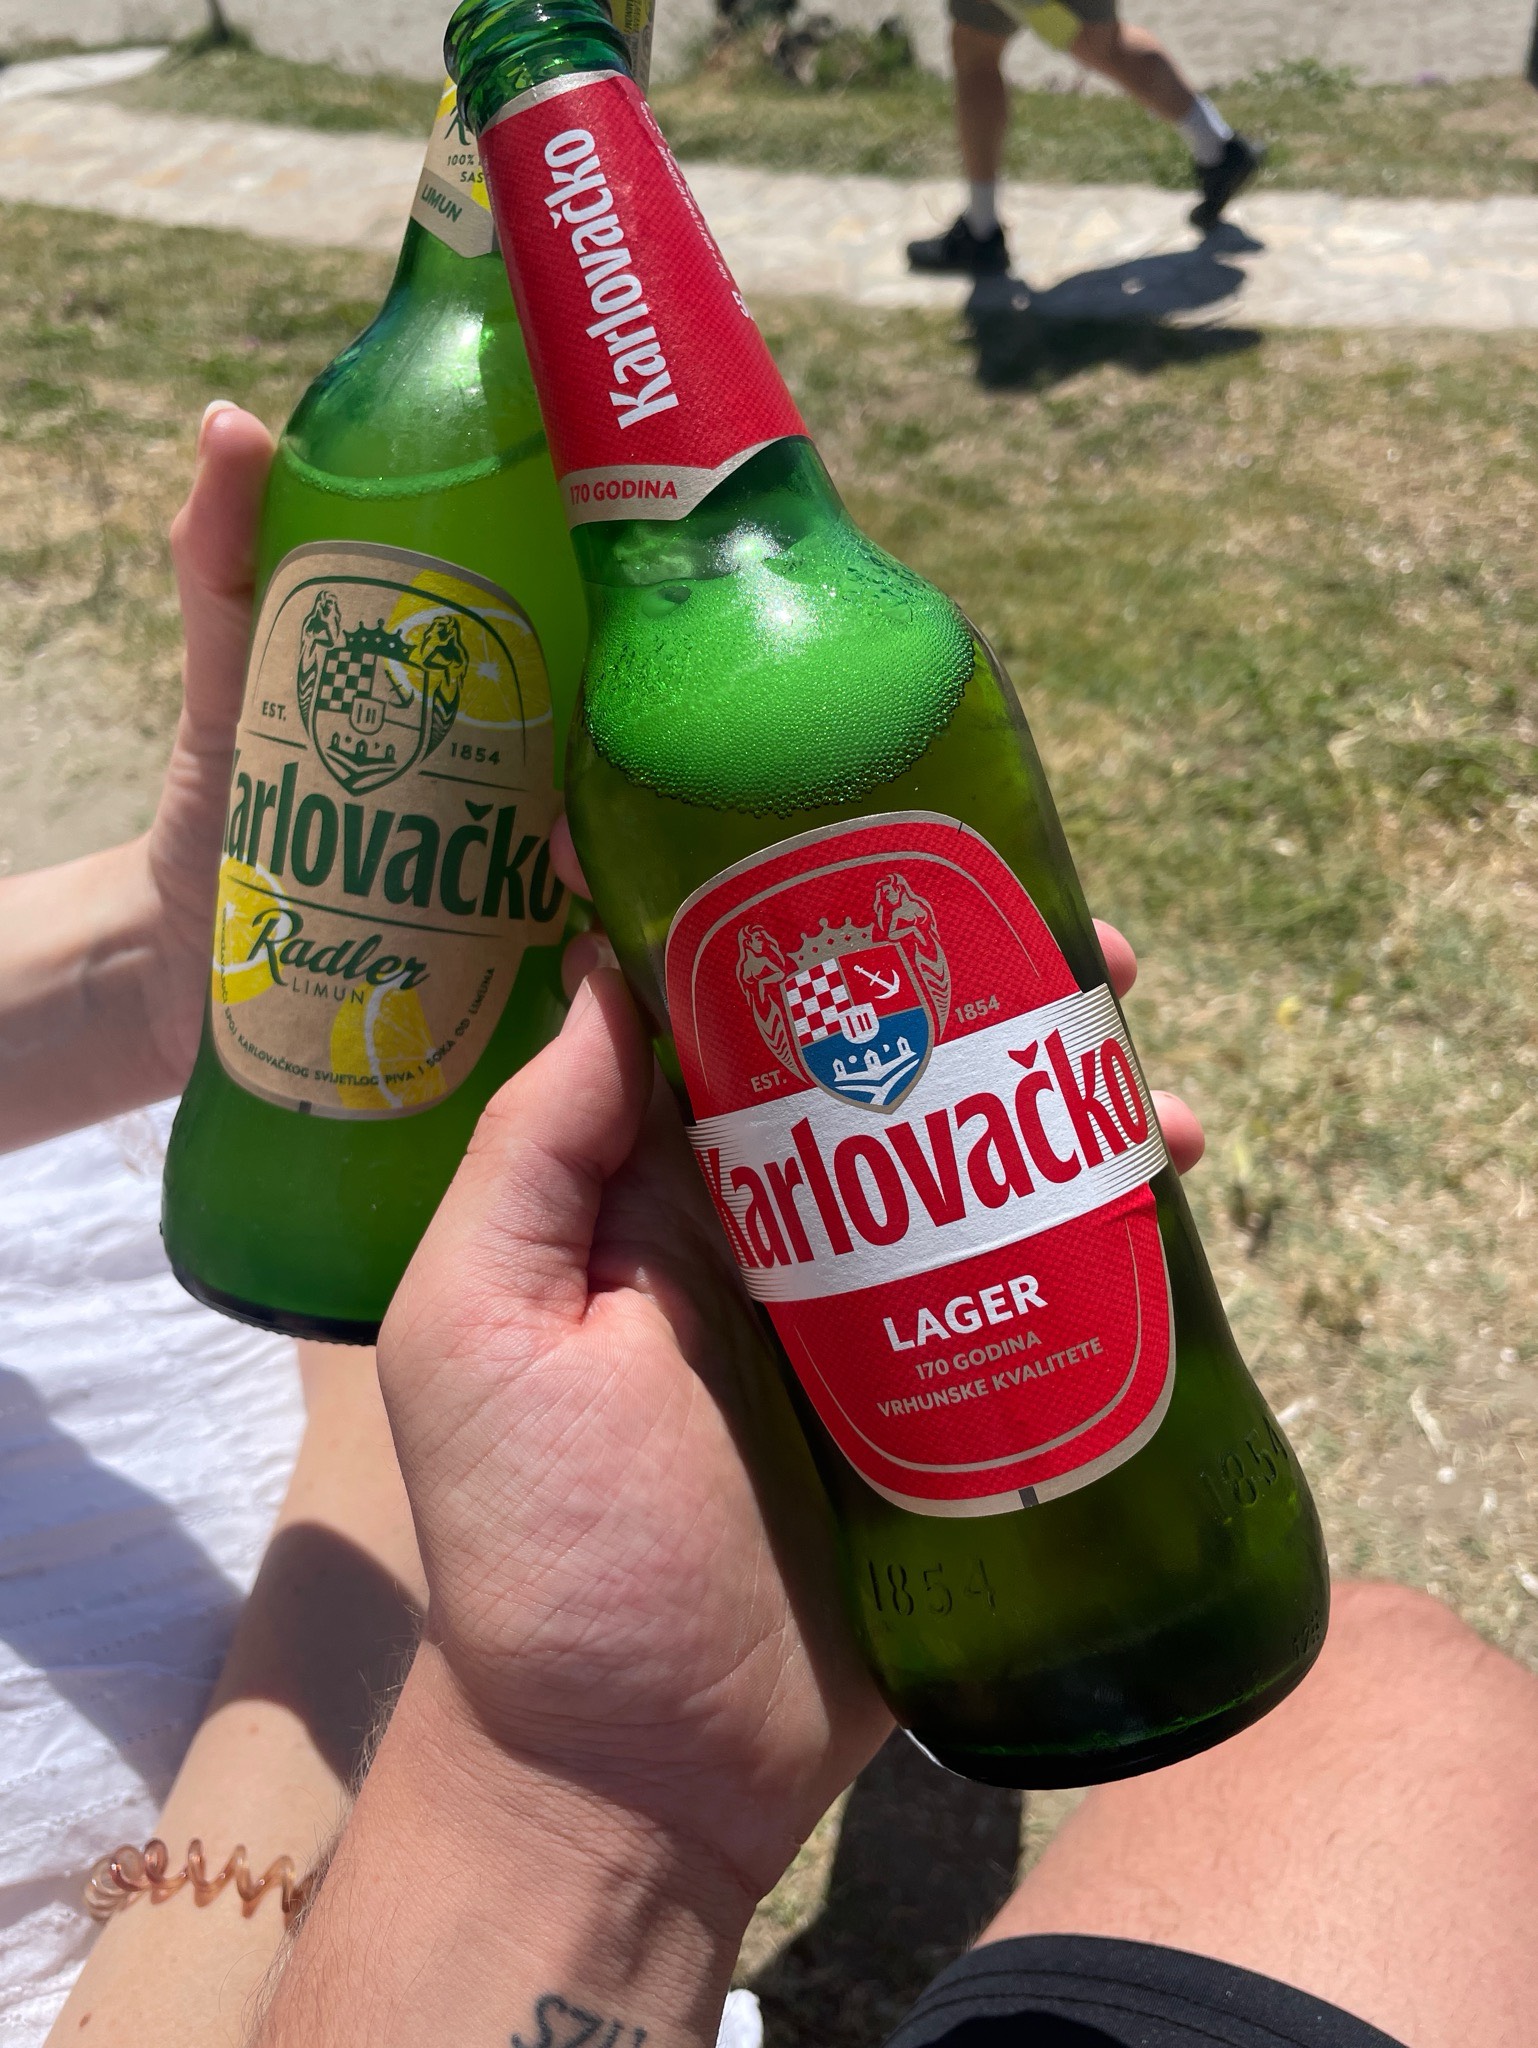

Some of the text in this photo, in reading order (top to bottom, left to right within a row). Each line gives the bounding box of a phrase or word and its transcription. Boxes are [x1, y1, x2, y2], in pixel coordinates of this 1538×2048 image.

[543, 128, 680, 430] Karlovačko
[570, 479, 678, 505] 170 GODINA
[261, 701, 287, 721] EST.
[451, 742, 501, 766] 1854
[223, 749, 566, 923] arlovačko
[247, 907, 431, 990] Radler
[293, 977, 365, 1005] LIMUN
[954, 994, 1001, 1024] 1854
[237, 1034, 310, 1079] KARLOVAČKOG
[314, 1069, 379, 1087] SVIJETLOG
[385, 1070, 415, 1084] PIVA
[426, 1040, 456, 1068] SOKA
[468, 967, 495, 1015] LIMUNA
[750, 1070, 788, 1093] EST.
[695, 1027, 1149, 1269] Karlovačko
[882, 1274, 1049, 1352] LAGER
[876, 1336, 1104, 1418] VRHUNSKE KVALITETE
[915, 1330, 1042, 1380] 170 GODINA
